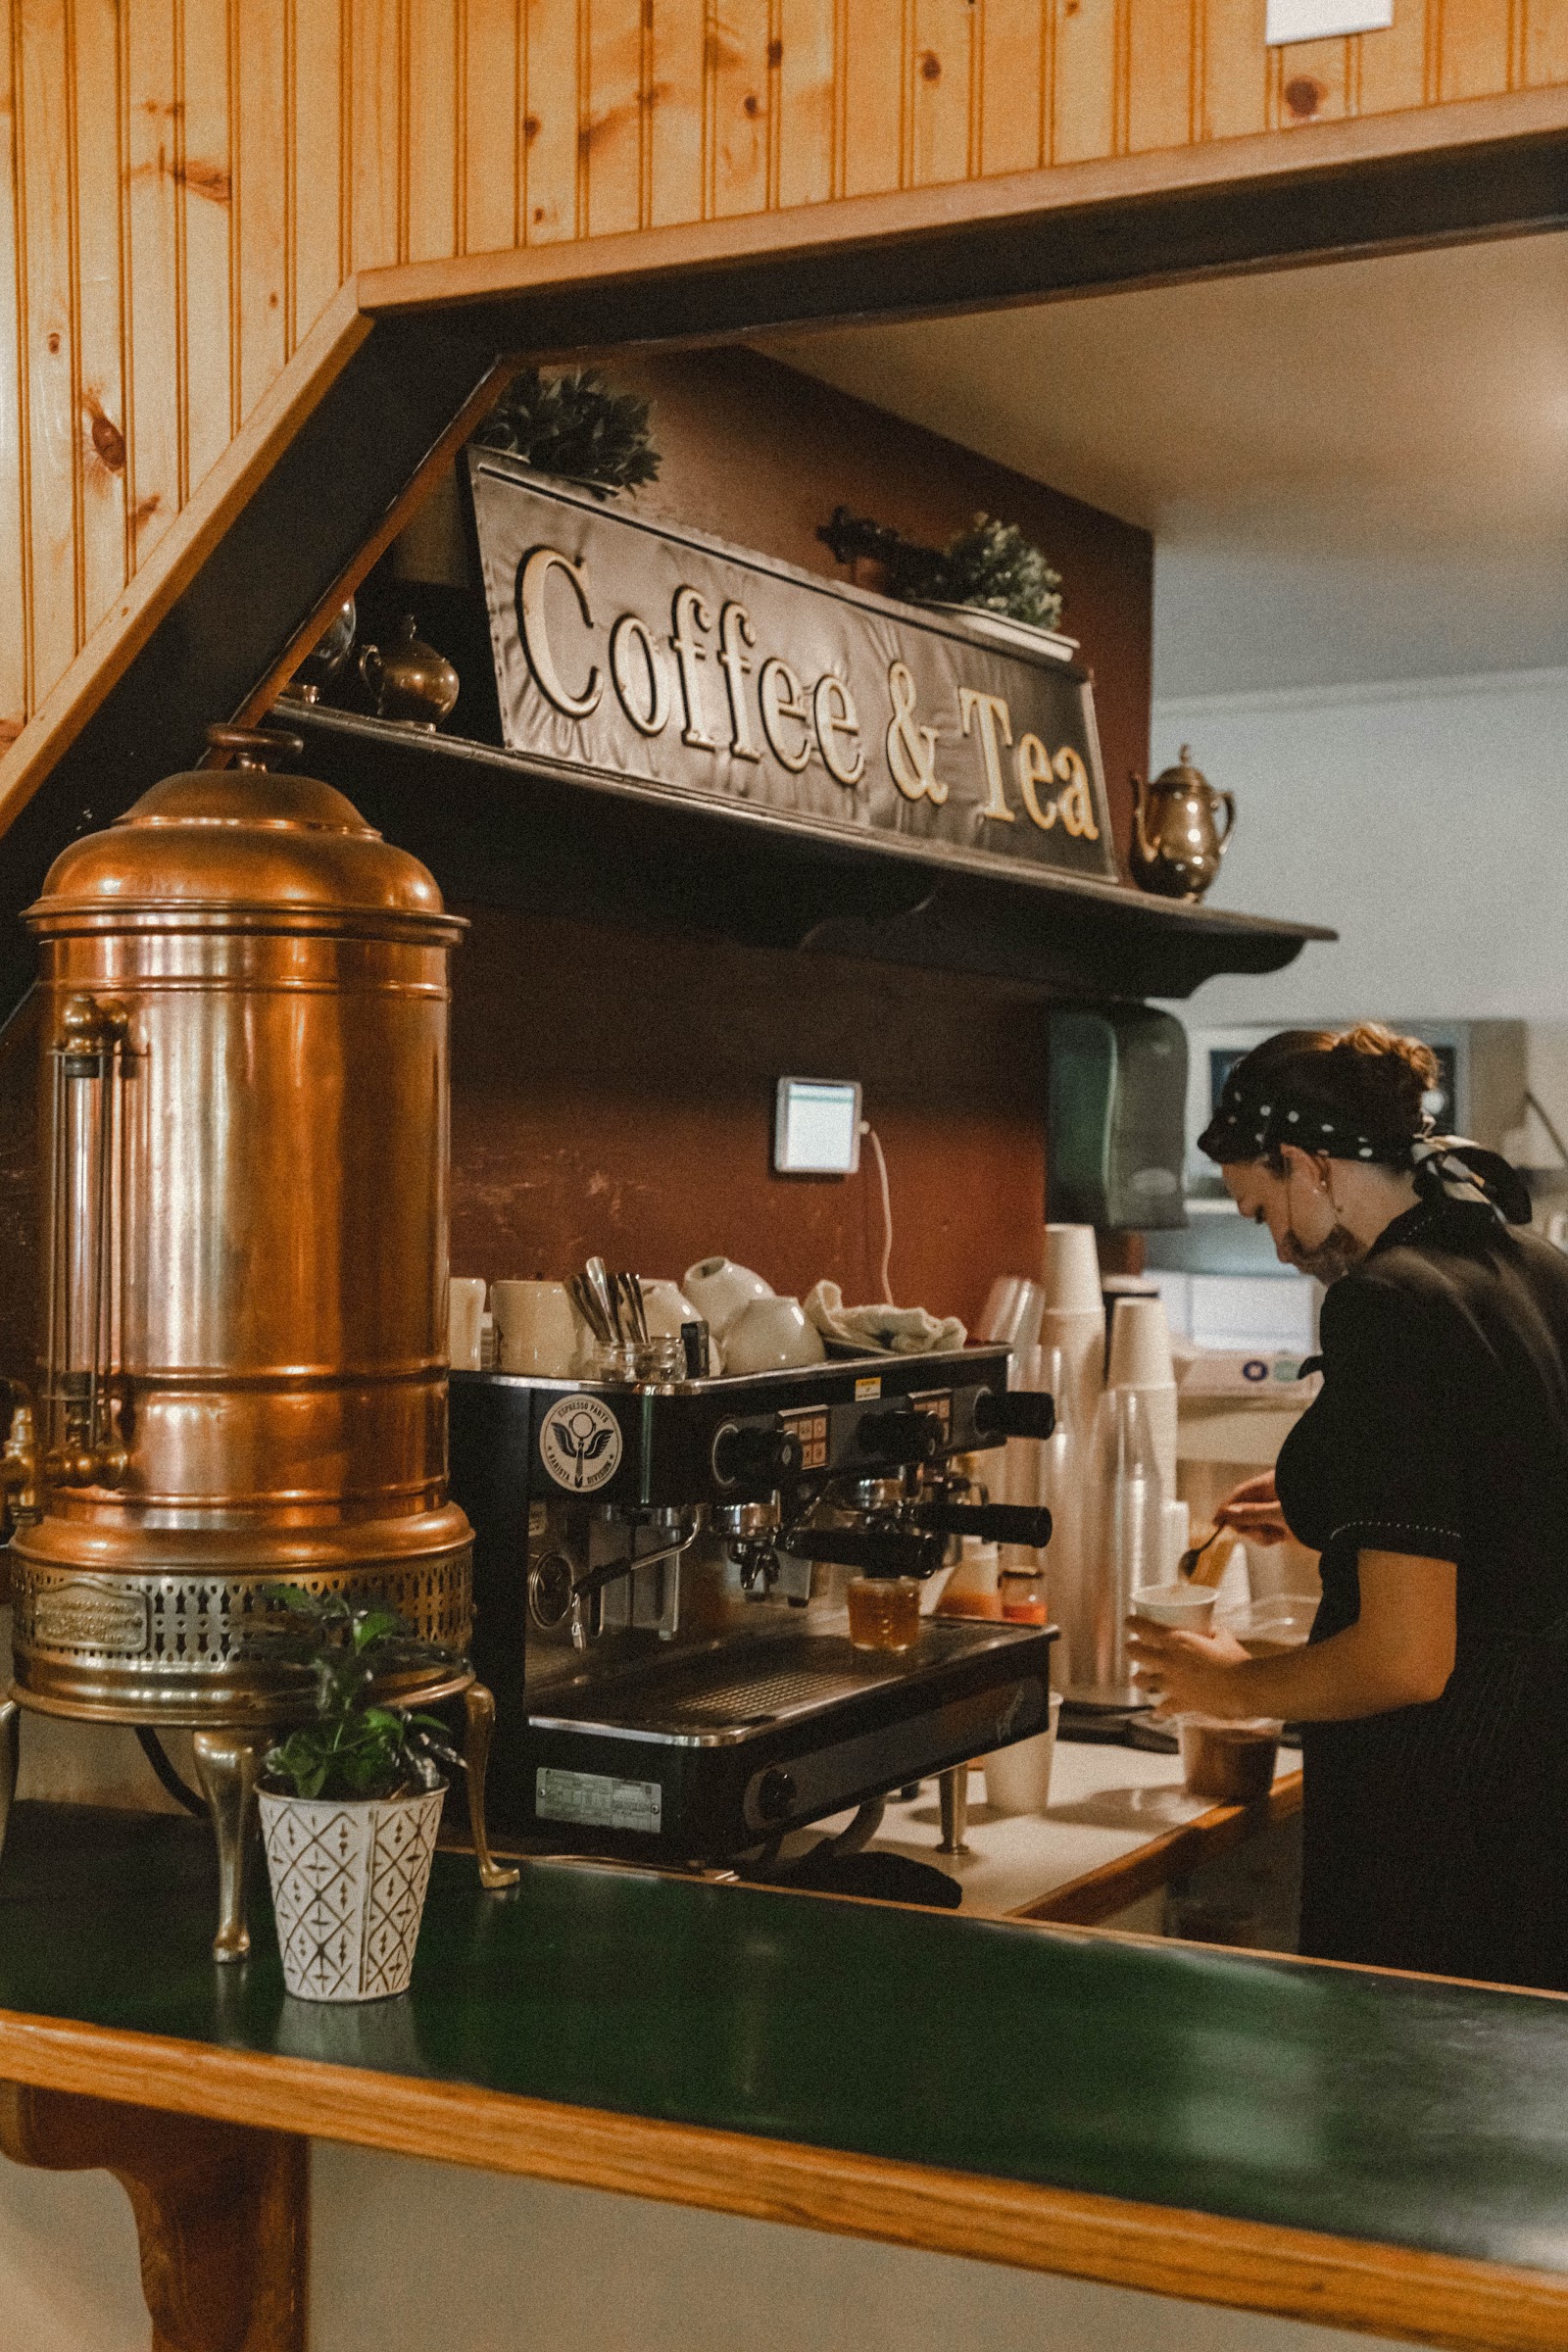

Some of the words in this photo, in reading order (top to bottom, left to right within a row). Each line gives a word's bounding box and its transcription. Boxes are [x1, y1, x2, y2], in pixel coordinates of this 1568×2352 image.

[514, 545, 864, 785] Coffee
[886, 661, 948, 805] &
[958, 687, 1100, 841] Tea
[558, 1402, 588, 1417] ESPRESSO
[590, 1404, 609, 1423] PARTS
[550, 1454, 570, 1481] BARISTA
